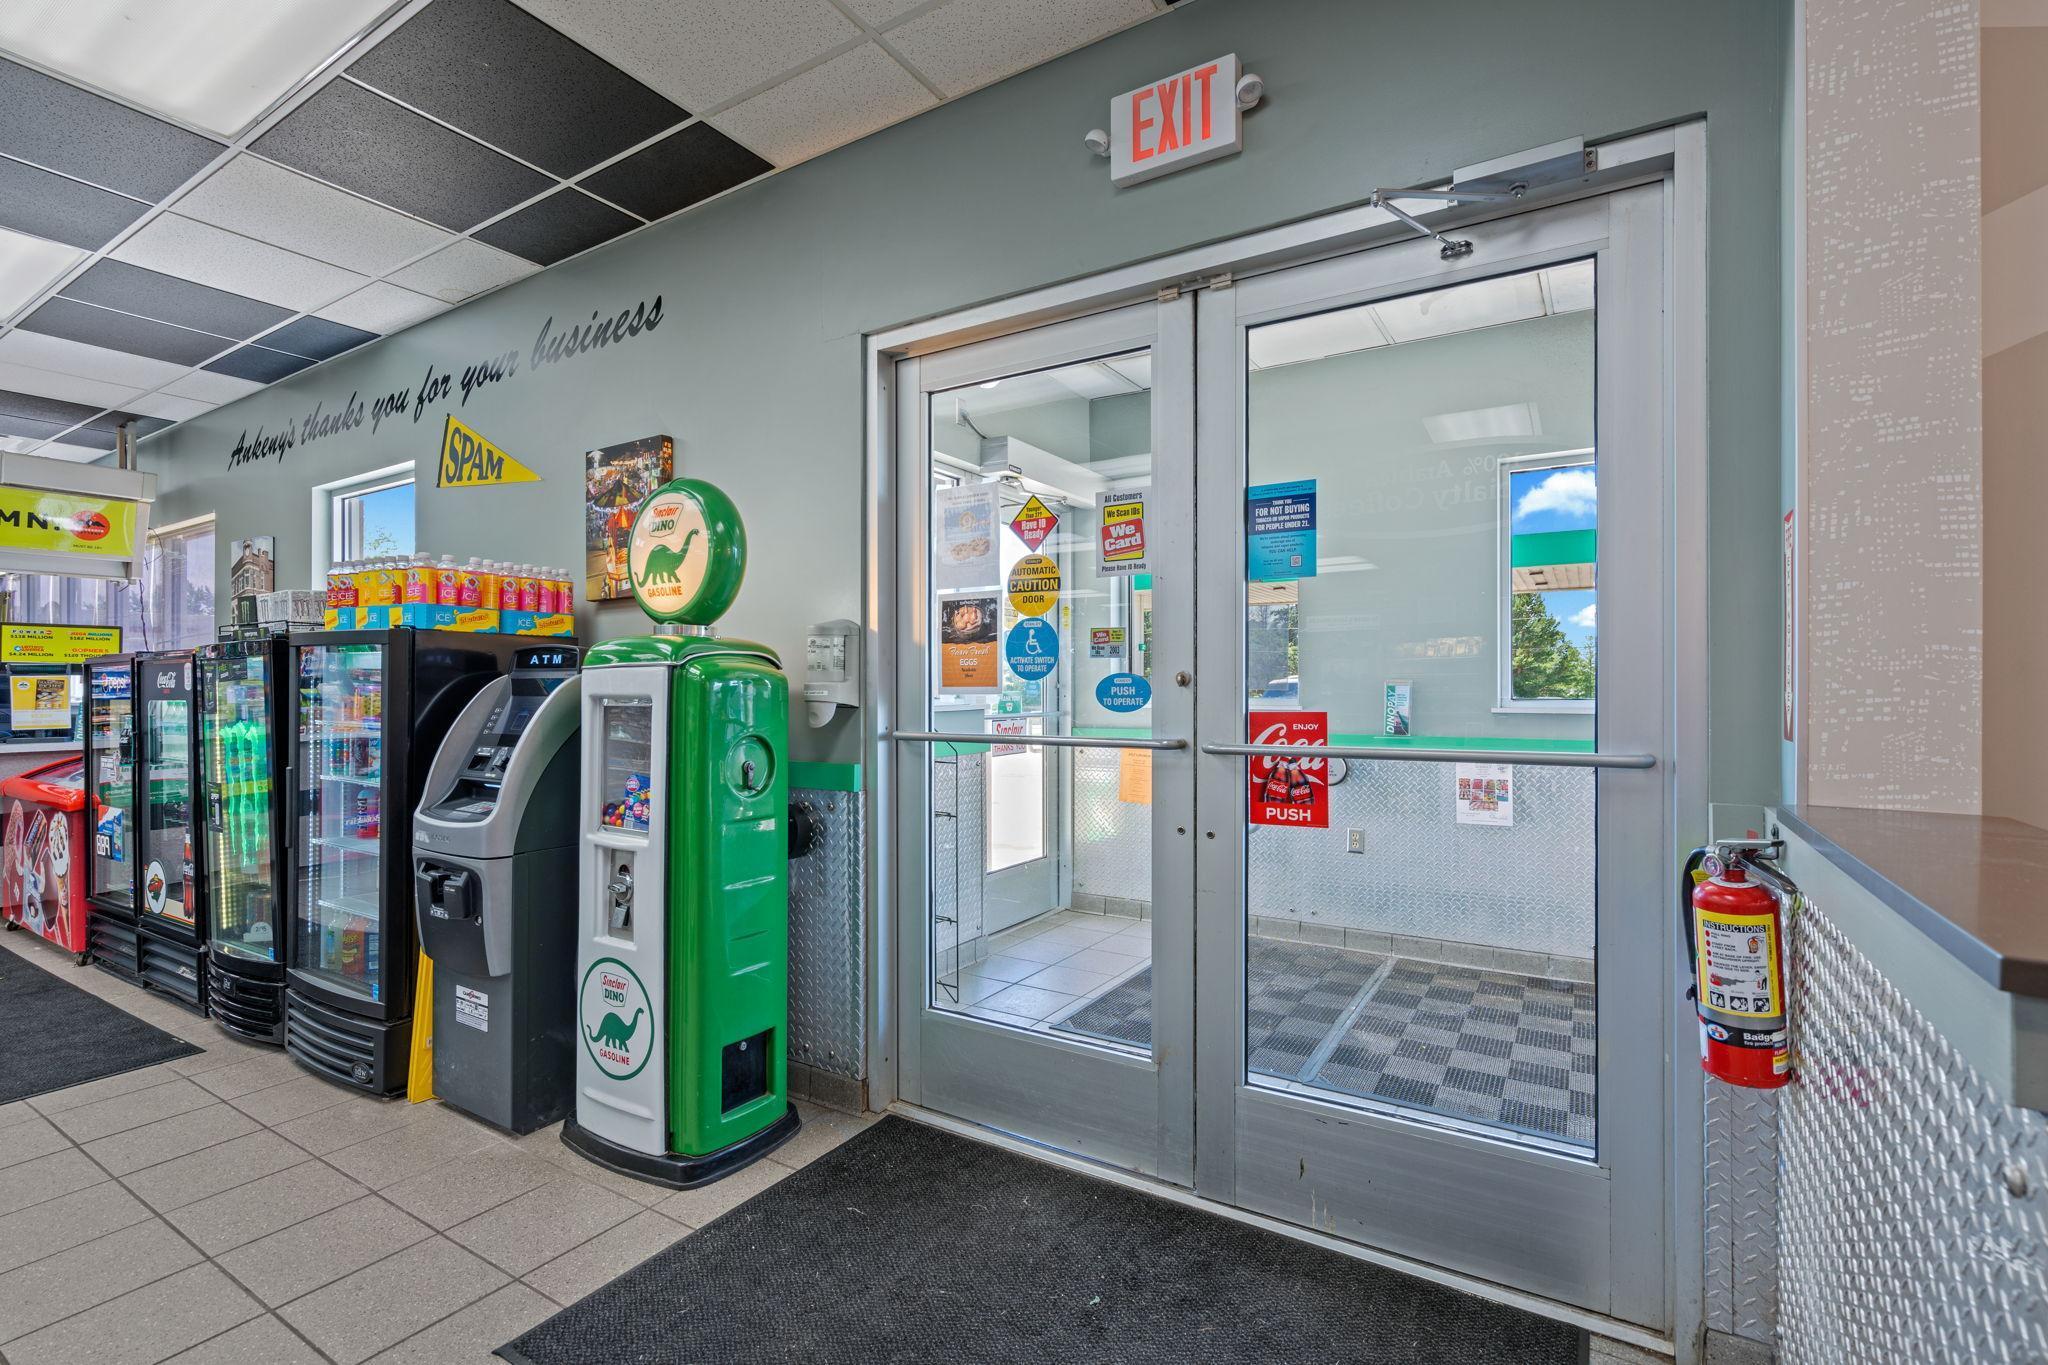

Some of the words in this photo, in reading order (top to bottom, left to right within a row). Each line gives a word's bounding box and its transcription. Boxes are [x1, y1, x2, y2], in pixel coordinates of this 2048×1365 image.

[1132, 64, 1217, 163] EXIT
[227, 417, 296, 472] Ankeny's
[301, 390, 365, 446] thanks
[372, 387, 408, 435] you
[413, 364, 452, 424] for
[460, 349, 520, 407] your
[530, 295, 665, 371] business
[445, 426, 505, 482] SPAM
[1104, 495, 1112, 503] All
[1113, 492, 1143, 502] Customers
[652, 505, 679, 519] Sinclair
[1107, 510, 1115, 518] We
[1116, 508, 1130, 517] Scan
[1131, 507, 1140, 515] IDs
[1255, 508, 1268, 517] FOR
[1270, 506, 1283, 515] NOT
[1285, 503, 1310, 514] BUYING
[651, 519, 675, 533] DINO
[1021, 520, 1037, 530] Have
[1039, 518, 1047, 528] ID
[1266, 522, 1284, 530] PEOPLE
[1024, 529, 1044, 540] Ready
[1109, 523, 1136, 538] We
[1104, 532, 1142, 551] Card
[1012, 566, 1056, 577] AUTOMATIC
[1010, 578, 1059, 592] CAUTION
[441, 589, 457, 598] ICE
[463, 590, 478, 599] ICE
[647, 585, 683, 598] GASOLINE
[503, 595, 518, 603] ICE
[1022, 594, 1045, 604] DOOR
[435, 613, 451, 622] ICE
[517, 619, 531, 627] ICE
[530, 654, 563, 665] ATM
[960, 658, 978, 666] EGGS
[1034, 656, 1055, 664] SWITCH
[1111, 686, 1135, 695] PUSH
[1103, 698, 1112, 706] TO
[1113, 697, 1144, 706] OPERATE
[1386, 689, 1396, 733] DINOPAY
[996, 722, 1023, 735] Sinclair
[1266, 807, 1311, 822] PUSH
[1703, 920, 1765, 933] INSTRUCTIONS
[602, 975, 627, 990] Sinclair
[604, 988, 625, 1003] DINO
[1743, 1032, 1773, 1042] Badg
[599, 1048, 630, 1066] GASOLINE
